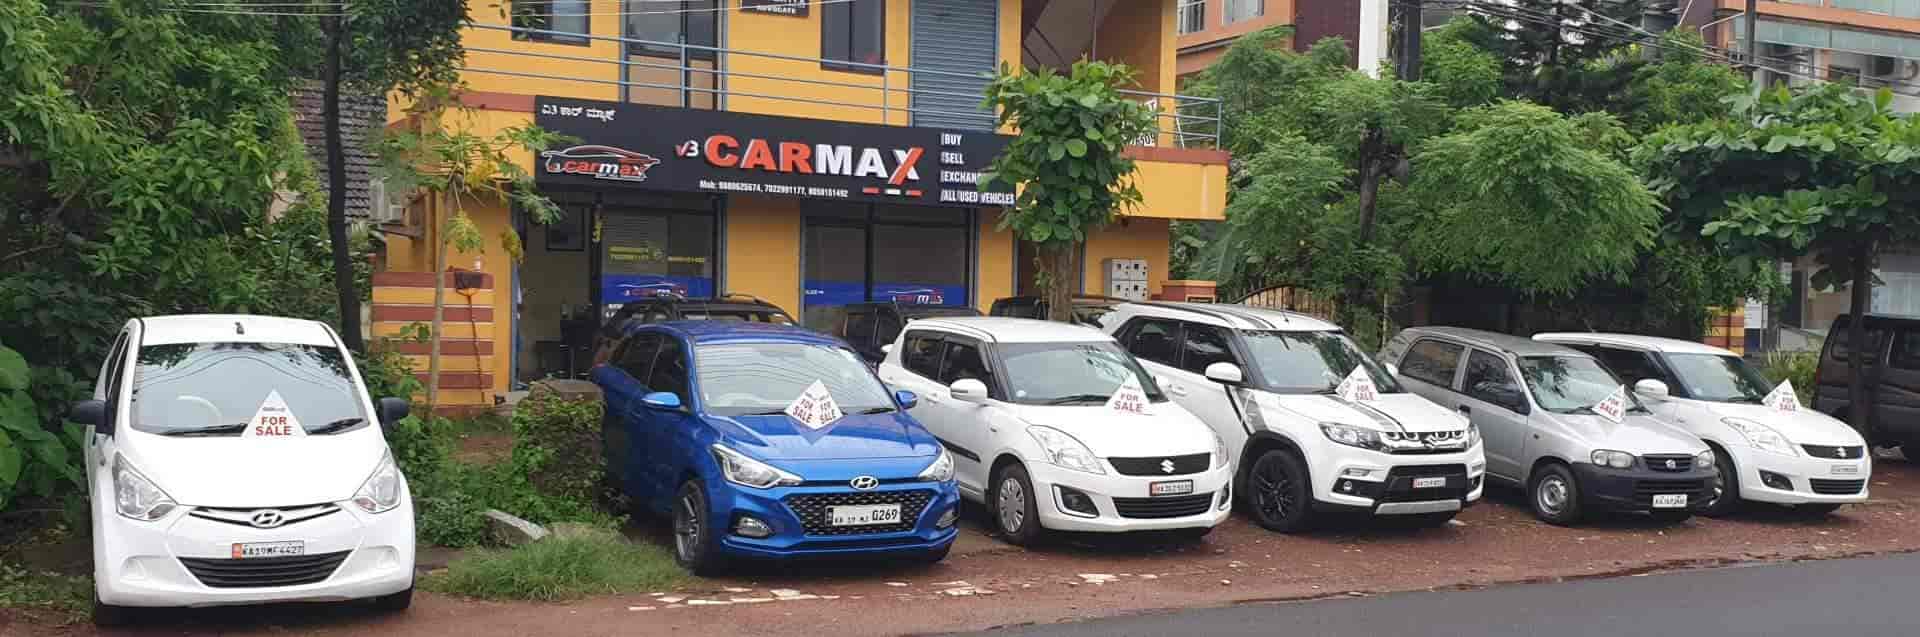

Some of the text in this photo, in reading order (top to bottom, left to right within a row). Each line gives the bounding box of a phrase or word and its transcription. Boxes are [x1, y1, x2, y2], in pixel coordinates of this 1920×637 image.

[944, 133, 961, 146] BUY
[704, 134, 924, 185] CARMAX
[944, 152, 964, 165] SELL
[564, 160, 648, 177] carmax
[944, 171, 977, 184] EXCHAN
[959, 191, 978, 203] USED
[980, 192, 1015, 204] VEHICLES
[800, 398, 814, 409] FOR
[1120, 393, 1138, 401] FOR
[1113, 401, 1143, 412] SALE
[261, 416, 287, 425] FOR
[792, 405, 813, 423] SALE
[256, 426, 291, 436] SALE
